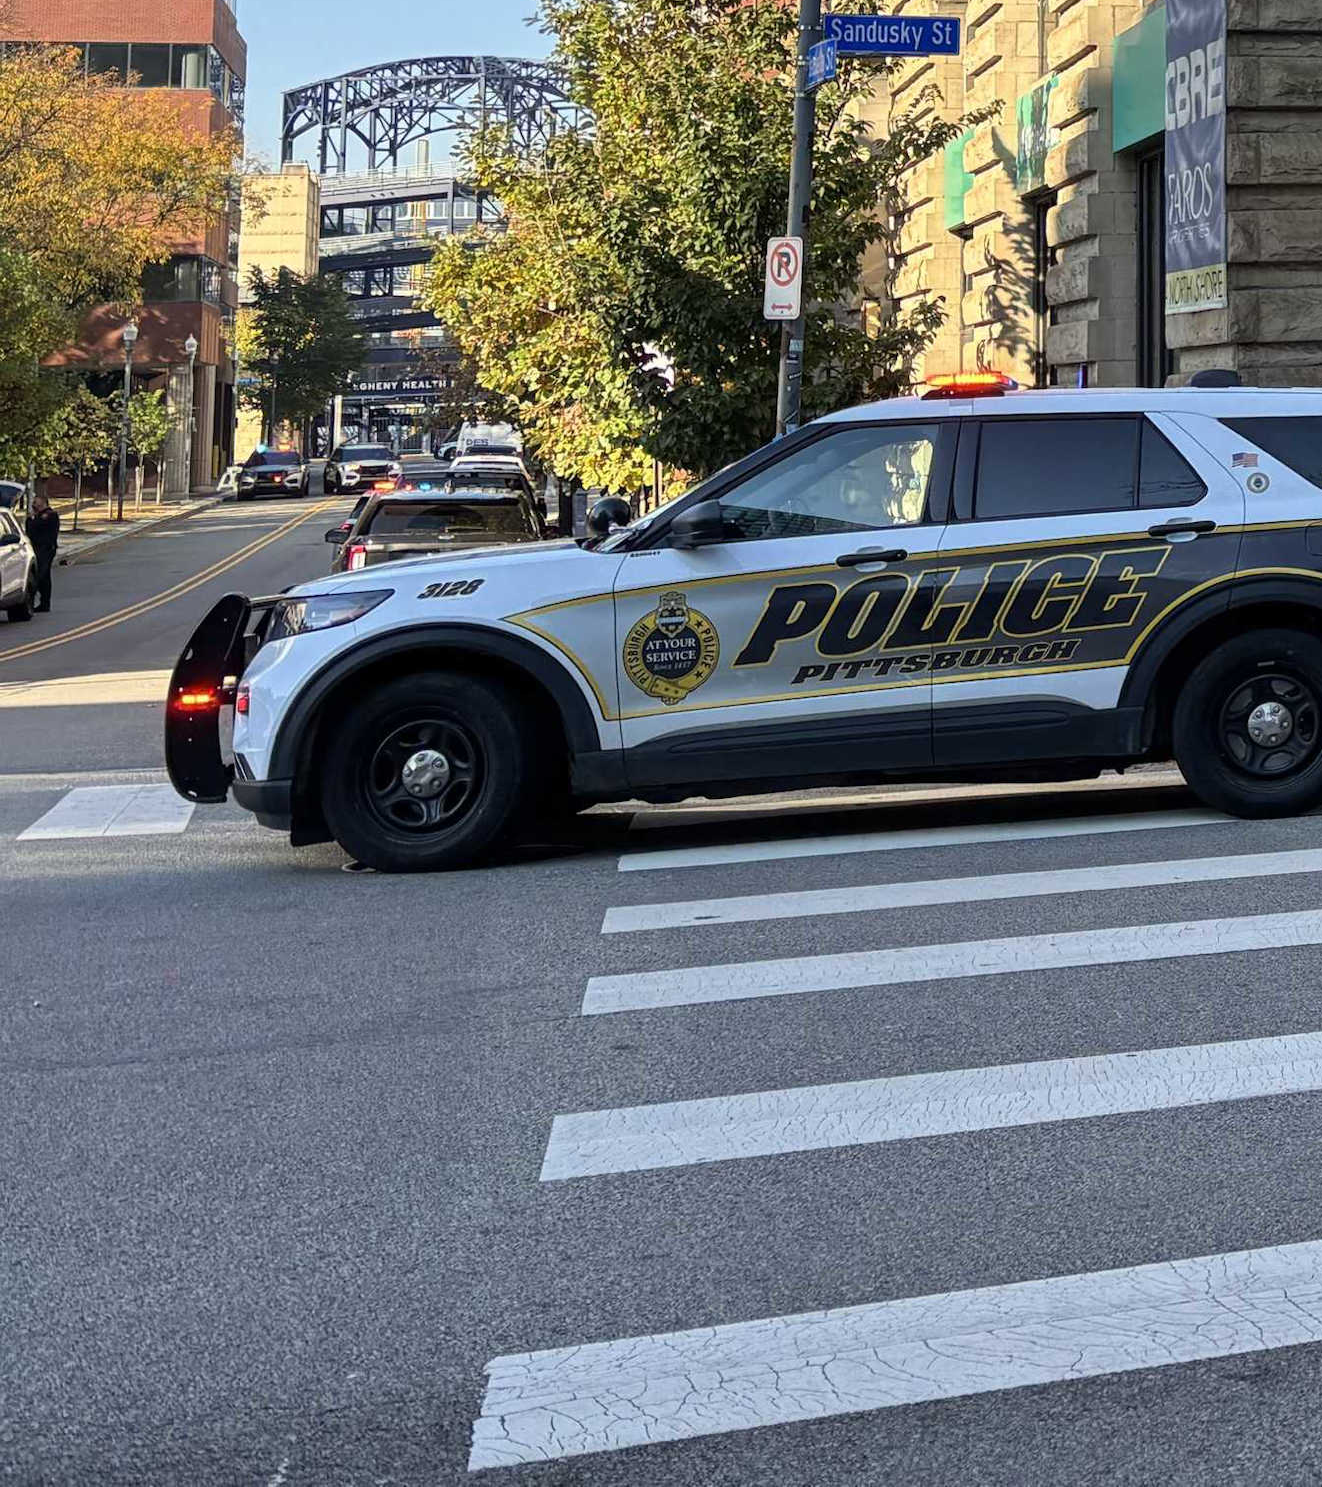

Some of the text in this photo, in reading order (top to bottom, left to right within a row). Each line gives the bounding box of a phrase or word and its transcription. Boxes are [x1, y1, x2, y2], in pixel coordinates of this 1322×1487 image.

[830, 18, 953, 50] Sandusky St
[1165, 37, 1224, 131] CBRE
[1194, 270, 1223, 302] SHORE
[353, 381, 398, 391] GHENY
[402, 380, 447, 389] HEALTH
[732, 545, 1172, 669] POLICE
[627, 623, 650, 685] PITTSBURGH
[646, 637, 696, 651] AT YOUR
[646, 650, 697, 663] SERVICE
[701, 628, 715, 669] POLICE
[790, 638, 1082, 685] PITTSBURGH
